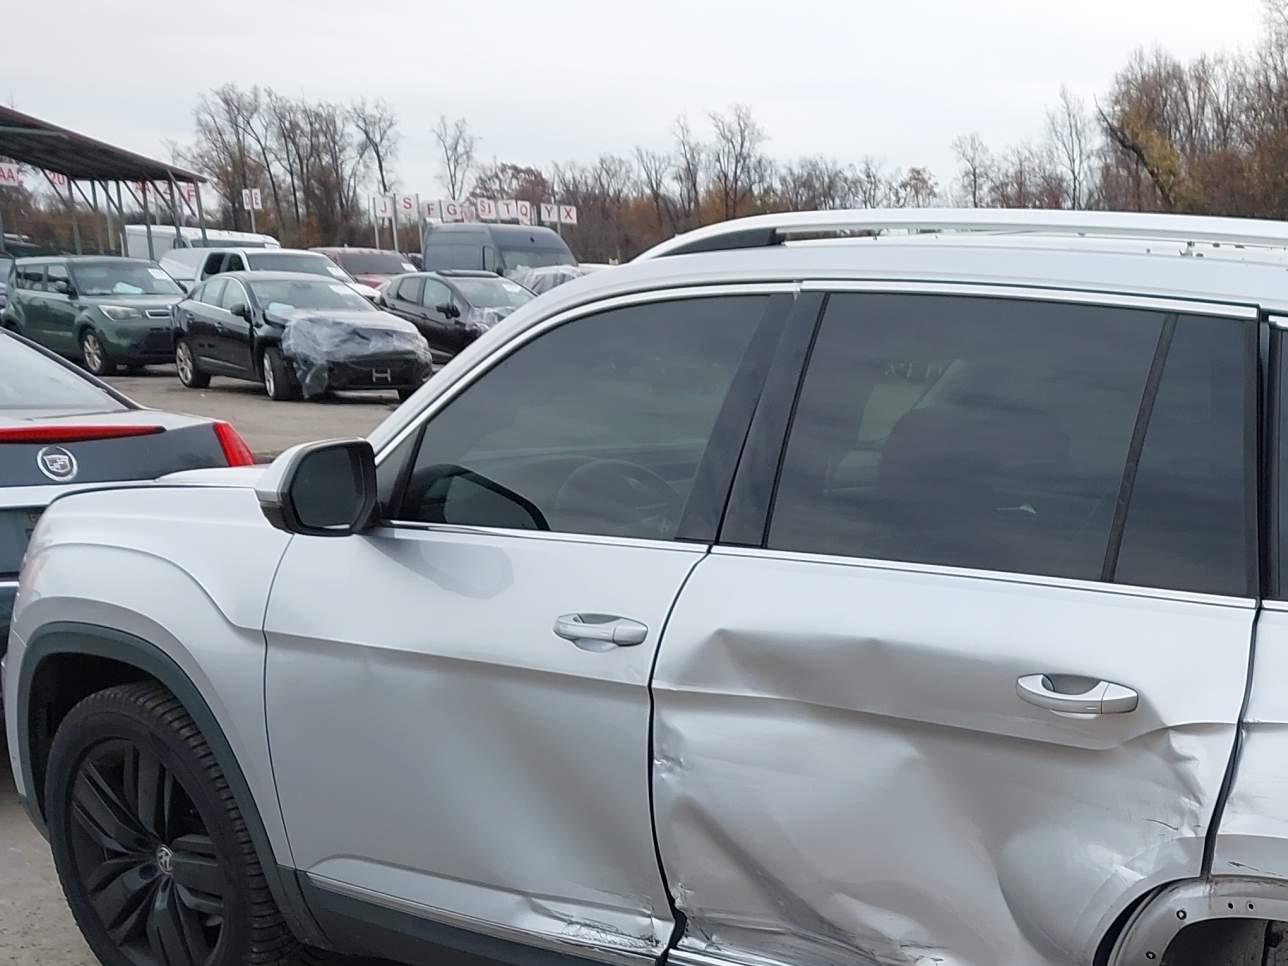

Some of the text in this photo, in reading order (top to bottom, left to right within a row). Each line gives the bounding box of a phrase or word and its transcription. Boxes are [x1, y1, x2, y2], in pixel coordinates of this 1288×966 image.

[402, 197, 412, 209] S
[446, 203, 457, 215] G
[563, 207, 572, 220] X
